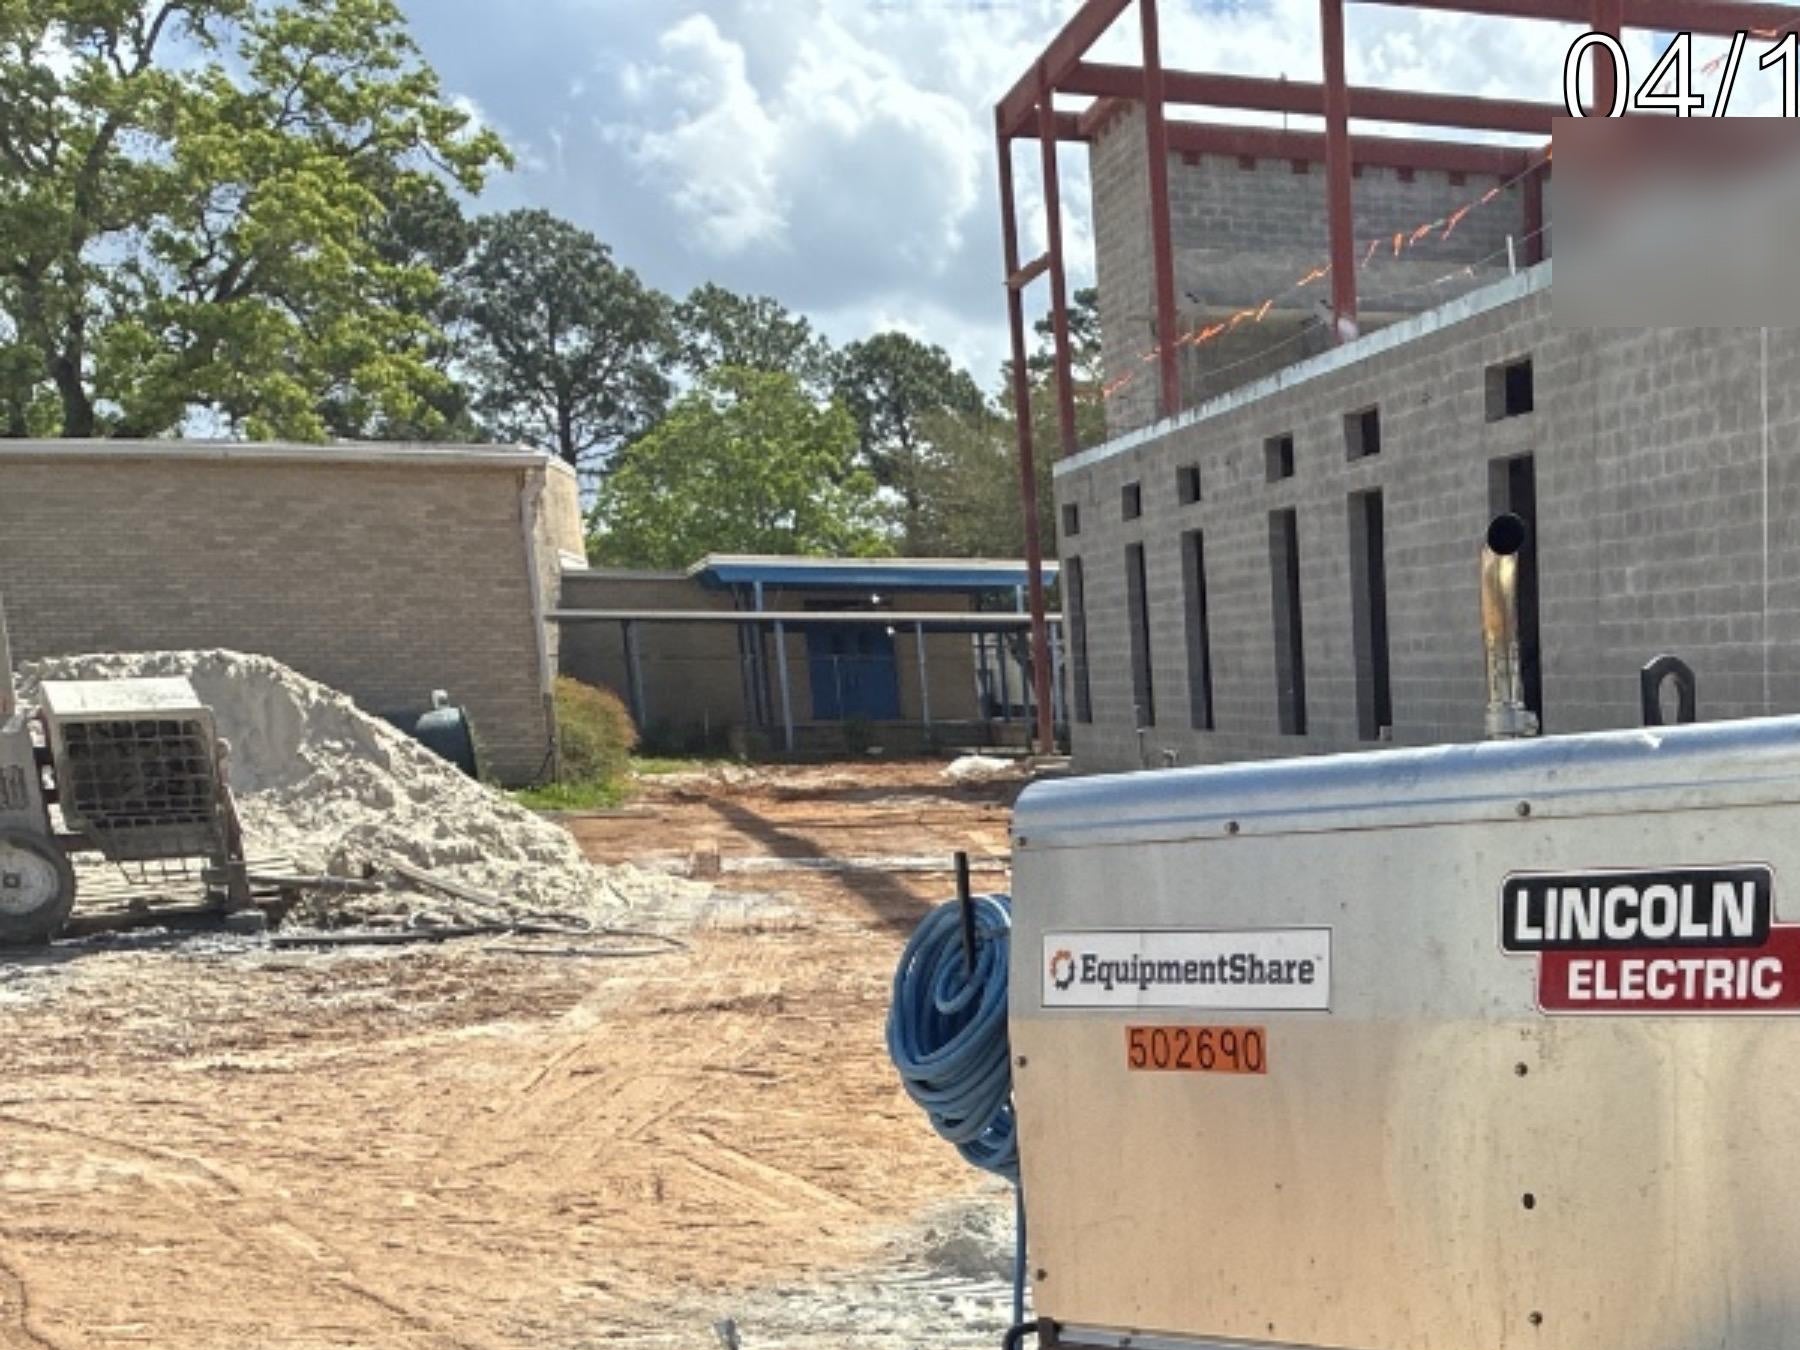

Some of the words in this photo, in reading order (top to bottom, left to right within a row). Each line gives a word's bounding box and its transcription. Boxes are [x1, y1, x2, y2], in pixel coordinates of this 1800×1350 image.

[1515, 881, 1756, 941] LINCOLN
[1080, 953, 1315, 990] EquipmentShare
[1567, 957, 1784, 1001] ELECTRIC
[1129, 1028, 1262, 1072] 502690
